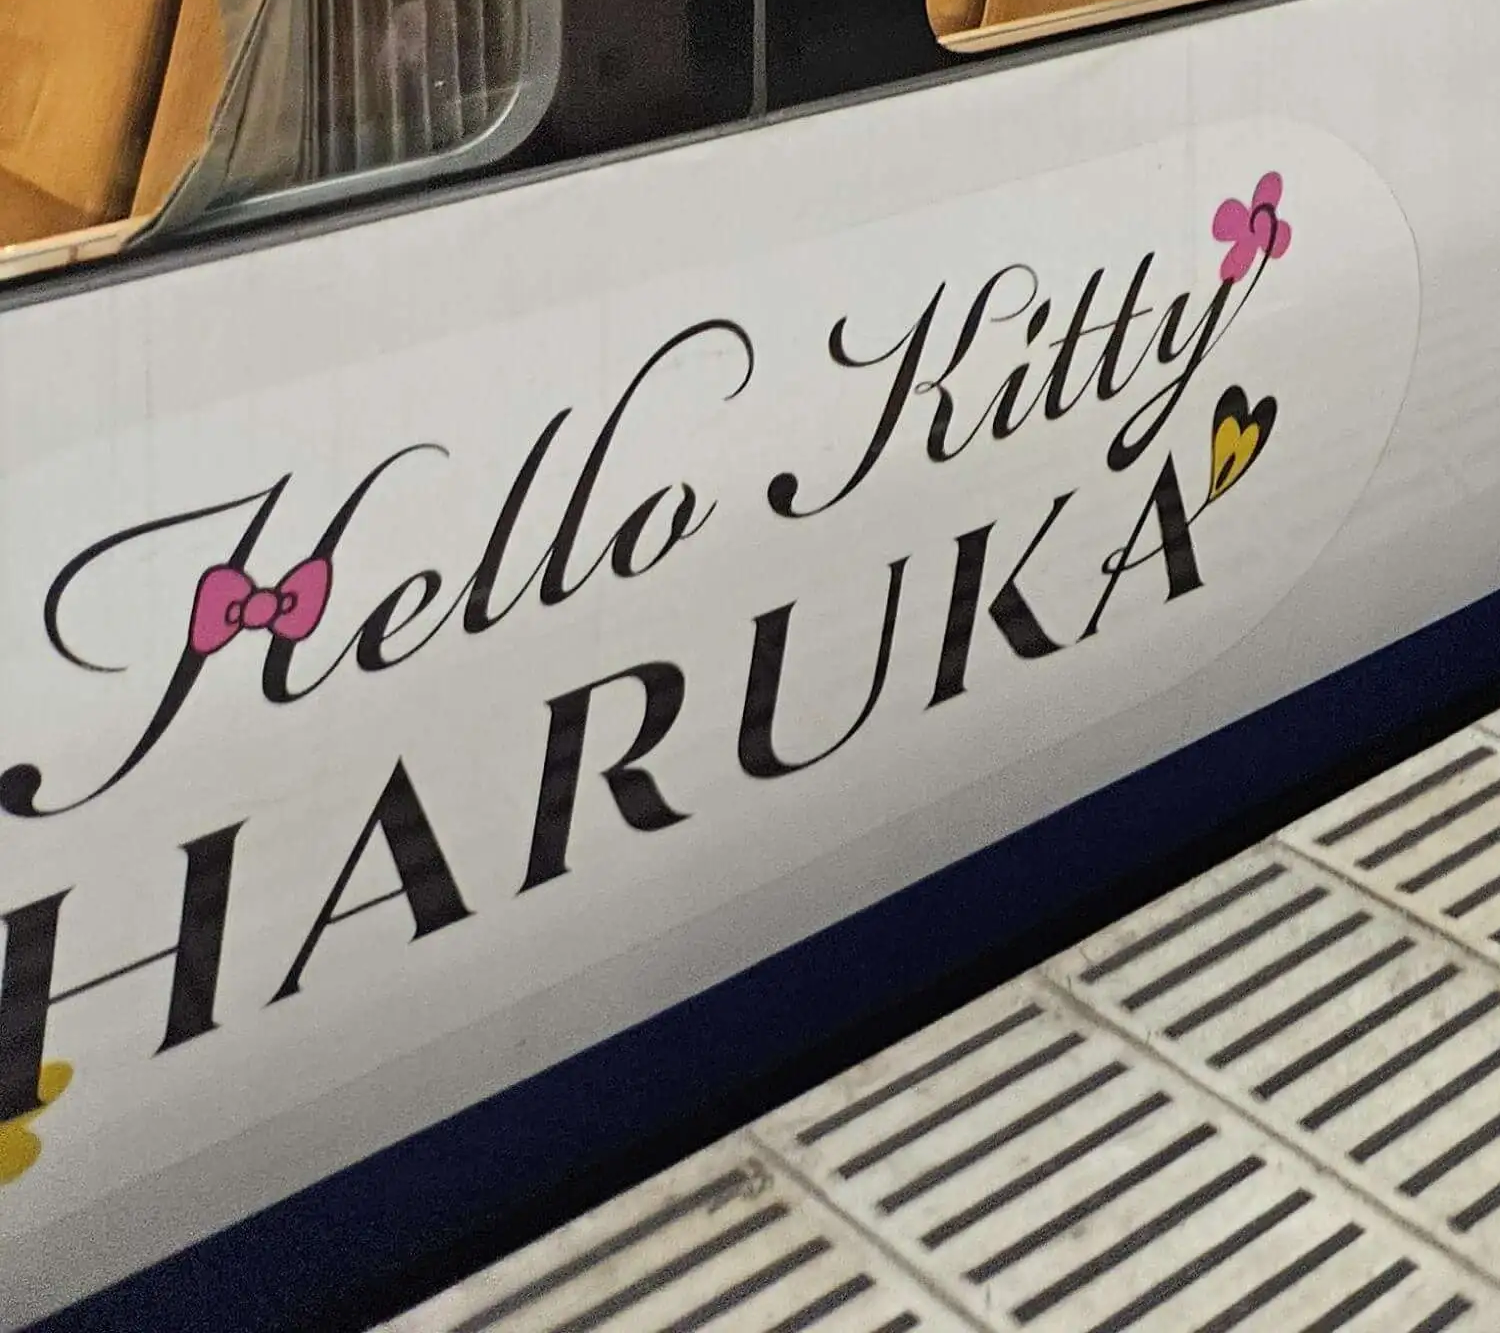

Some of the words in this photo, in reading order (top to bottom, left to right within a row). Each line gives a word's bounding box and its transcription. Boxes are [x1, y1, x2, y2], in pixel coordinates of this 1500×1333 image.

[0, 319, 755, 820] Hello
[767, 201, 1278, 520] Kitty
[0, 451, 1206, 1117] HARUKA
